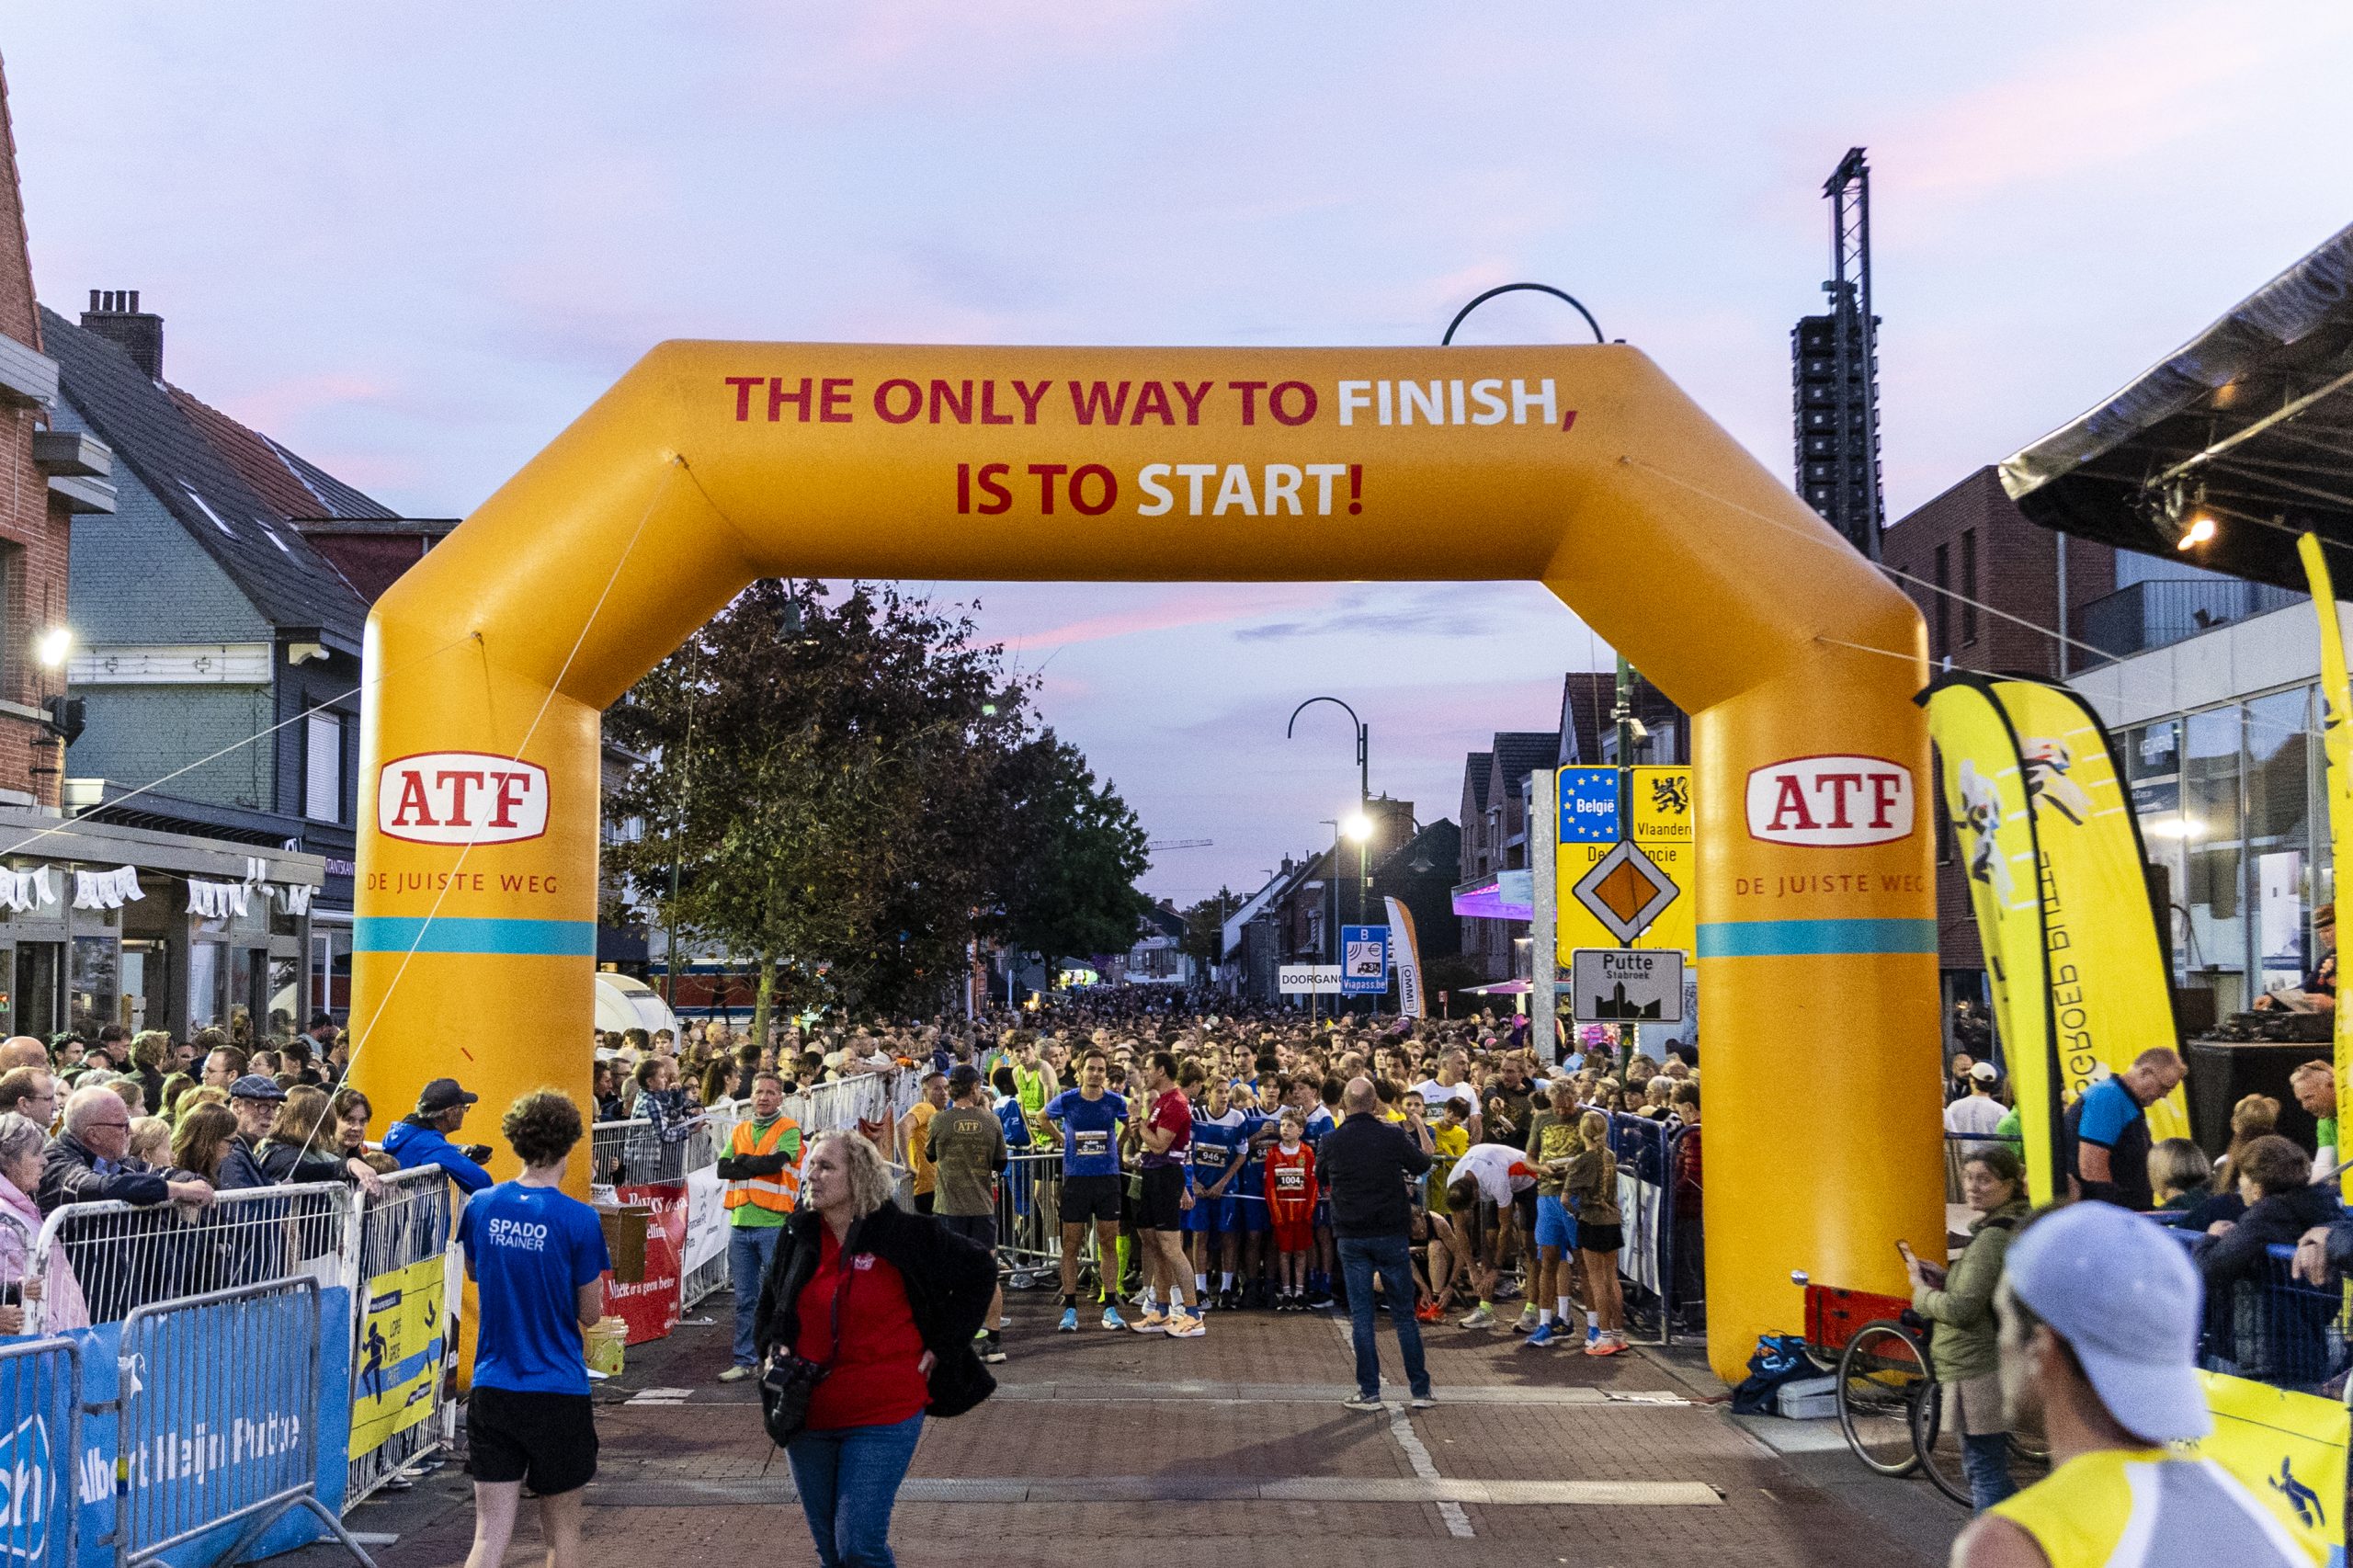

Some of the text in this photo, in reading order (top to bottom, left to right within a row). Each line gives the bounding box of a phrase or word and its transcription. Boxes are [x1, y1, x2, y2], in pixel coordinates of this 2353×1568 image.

[725, 377, 1578, 432] THE ONLY WAY TO FINISH,
[957, 463, 1362, 516] IS TO START!
[392, 770, 530, 828] ATF
[1576, 799, 1615, 816] België
[1767, 774, 1901, 831] ATF
[369, 873, 557, 893] DE JUISTE WEG
[1736, 879, 1765, 895] DE
[1778, 874, 1870, 897] JUISTE
[1360, 929, 1369, 940] B
[1603, 954, 1654, 970] Putte
[1607, 971, 1651, 980] Stabroek
[1344, 979, 1386, 992] Viapass.be
[958, 1121, 979, 1131] ATF
[1202, 1151, 1220, 1162] 946
[1256, 1149, 1267, 1157] 94
[1281, 1176, 1302, 1185] 1004
[489, 1218, 548, 1239] SPADO
[488, 1233, 545, 1252] TRAINER
[157, 1424, 225, 1485] Heijn
[233, 1410, 300, 1464] Putte
